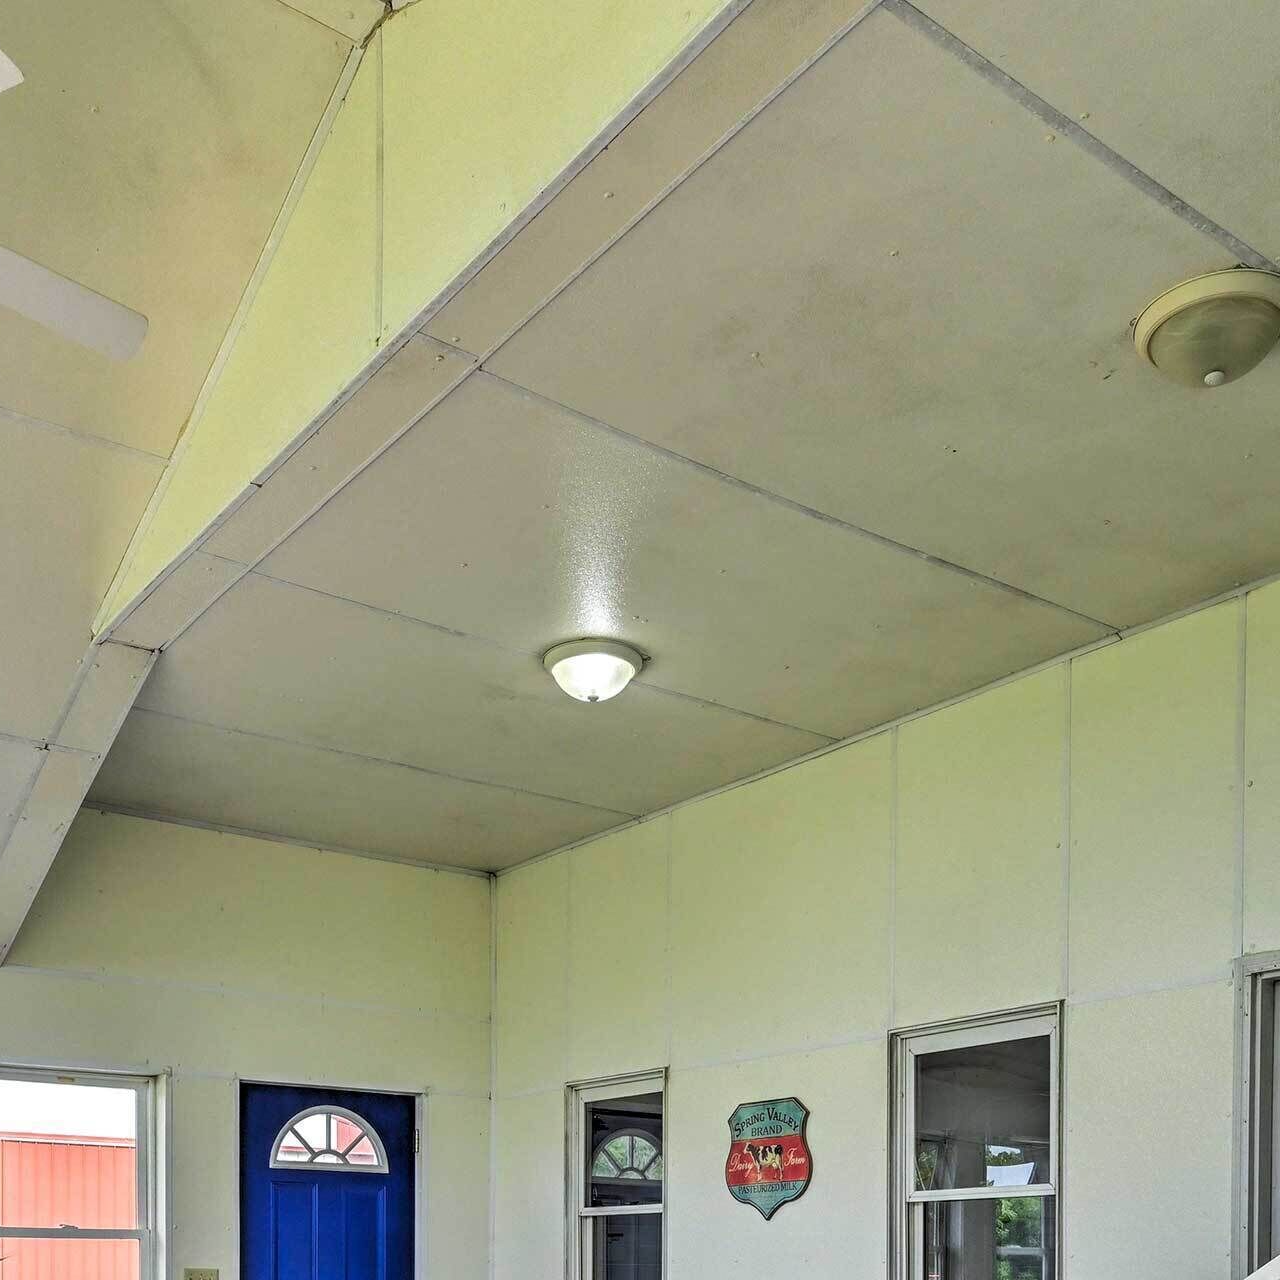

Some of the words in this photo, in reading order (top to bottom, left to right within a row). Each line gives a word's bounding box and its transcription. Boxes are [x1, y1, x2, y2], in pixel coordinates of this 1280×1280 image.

[735, 1112, 765, 1137] SPRING
[766, 1107, 799, 1131] VALLEY
[751, 1125, 783, 1137] BRAND
[728, 1152, 755, 1178] Dairy
[784, 1147, 806, 1166] Farm
[738, 1184, 780, 1195] PASTEURIZED
[780, 1182, 798, 1192] MILK
